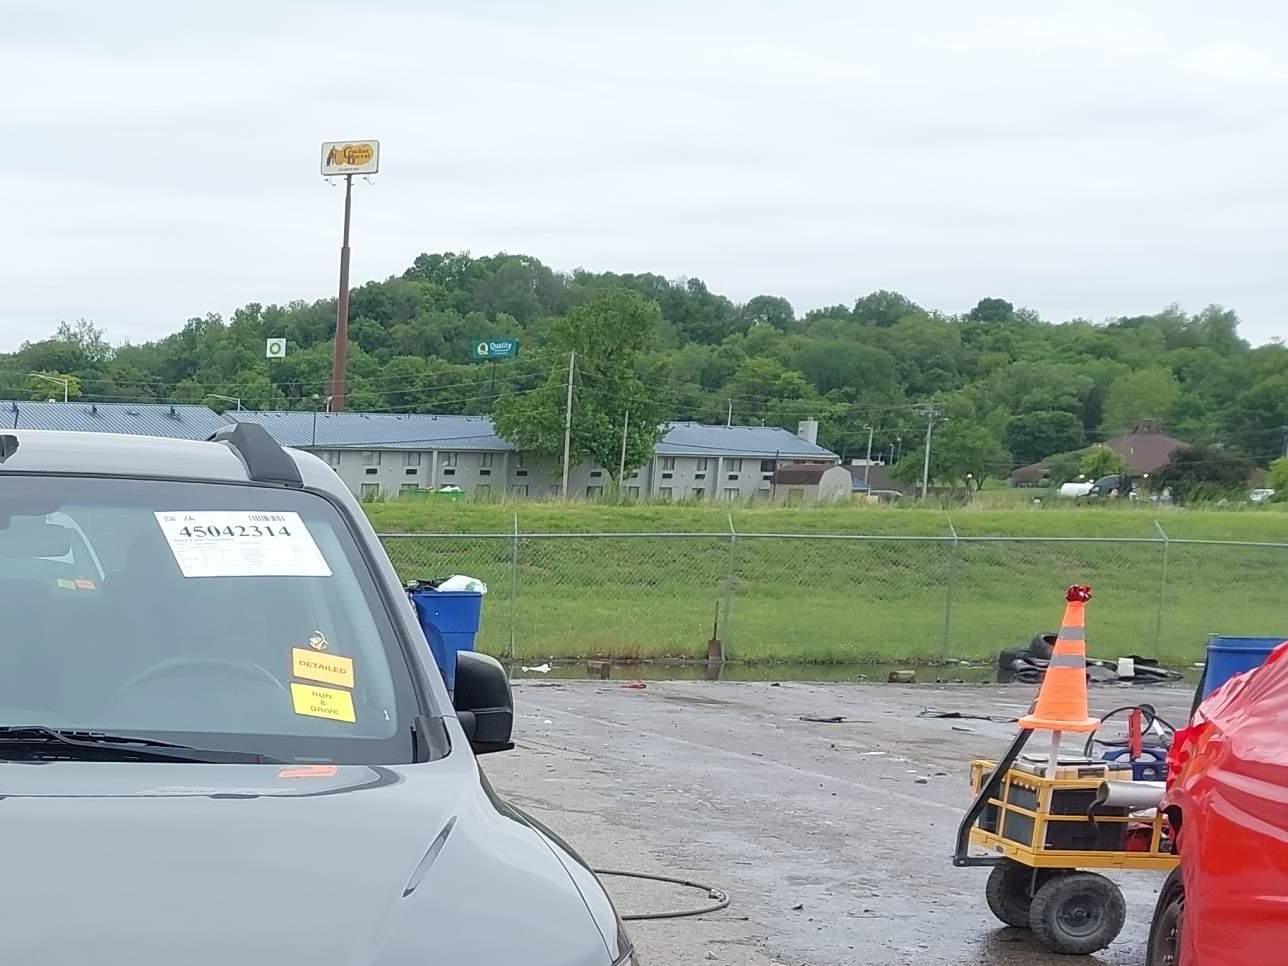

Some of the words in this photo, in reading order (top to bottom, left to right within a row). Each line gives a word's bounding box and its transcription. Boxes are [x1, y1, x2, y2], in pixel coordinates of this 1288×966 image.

[489, 342, 513, 352] Quality
[179, 526, 292, 538] 45042314
[299, 660, 347, 674] DETAILED
[312, 691, 332, 700] RUN
[310, 706, 339, 716] DRIVE
